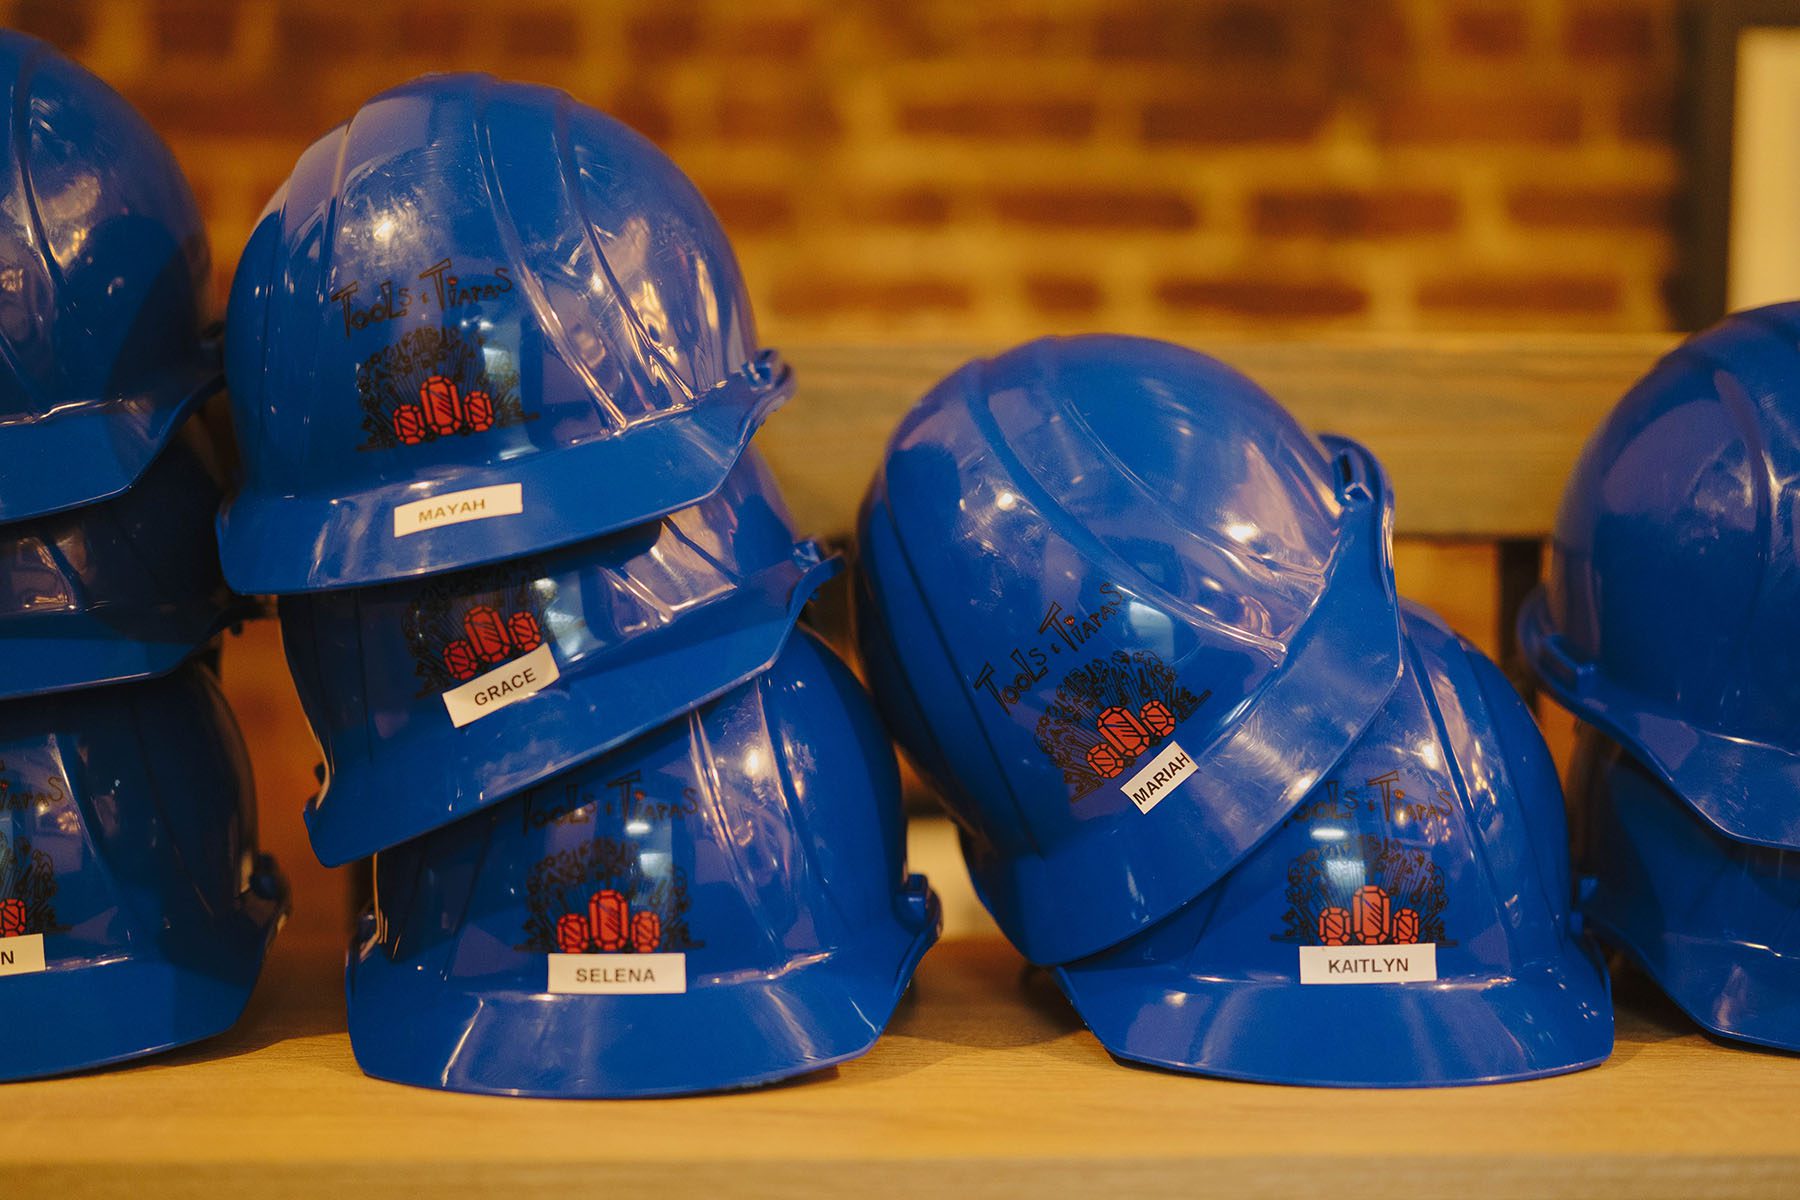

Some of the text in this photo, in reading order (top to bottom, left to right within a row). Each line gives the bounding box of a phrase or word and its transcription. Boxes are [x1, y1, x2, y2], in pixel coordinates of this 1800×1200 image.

[418, 498, 486, 523] MAYAH
[474, 667, 537, 706] GRACE
[1132, 752, 1191, 805] MARIAH
[575, 967, 657, 983] SELENA
[1328, 957, 1409, 974] KAITLYN
